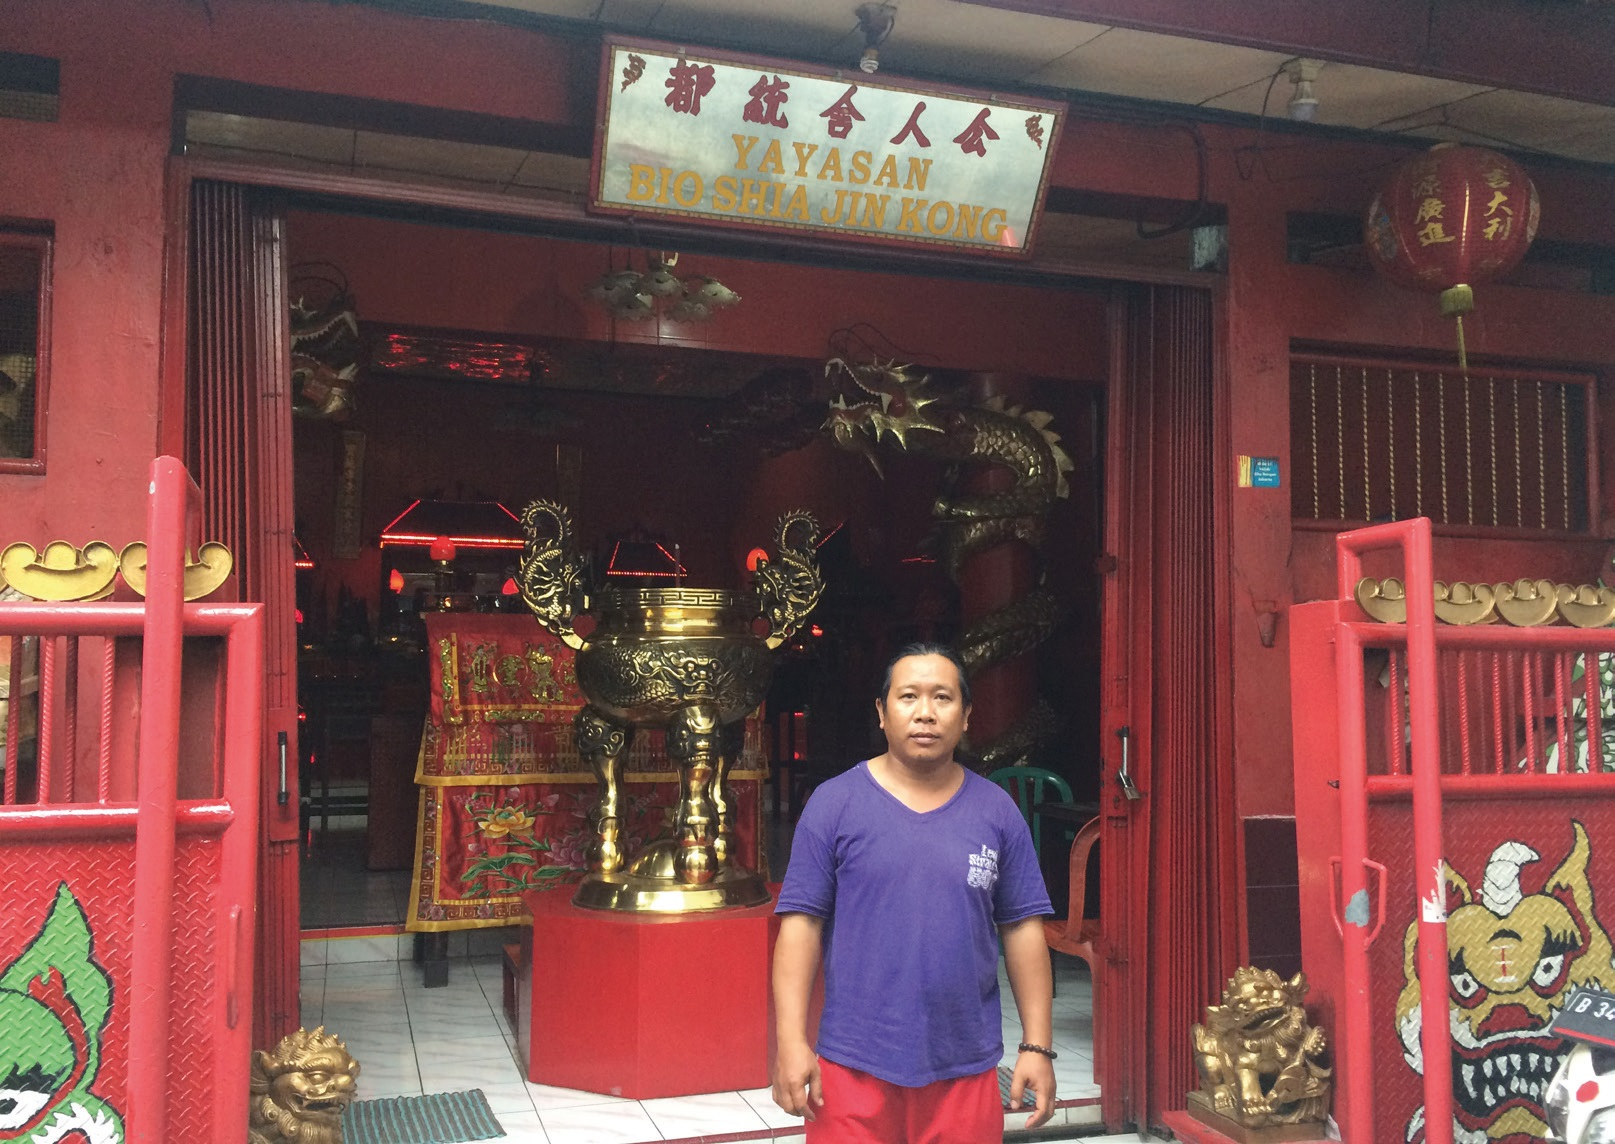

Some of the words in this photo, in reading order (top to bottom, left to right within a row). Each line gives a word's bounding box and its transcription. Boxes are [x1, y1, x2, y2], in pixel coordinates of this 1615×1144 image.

[731, 133, 933, 192] YAYASAN
[627, 163, 703, 207] BIO
[712, 168, 811, 221] SHIA
[820, 188, 889, 230] JIN
[896, 197, 1009, 242] KONG
[1574, 997, 1593, 1014] B
